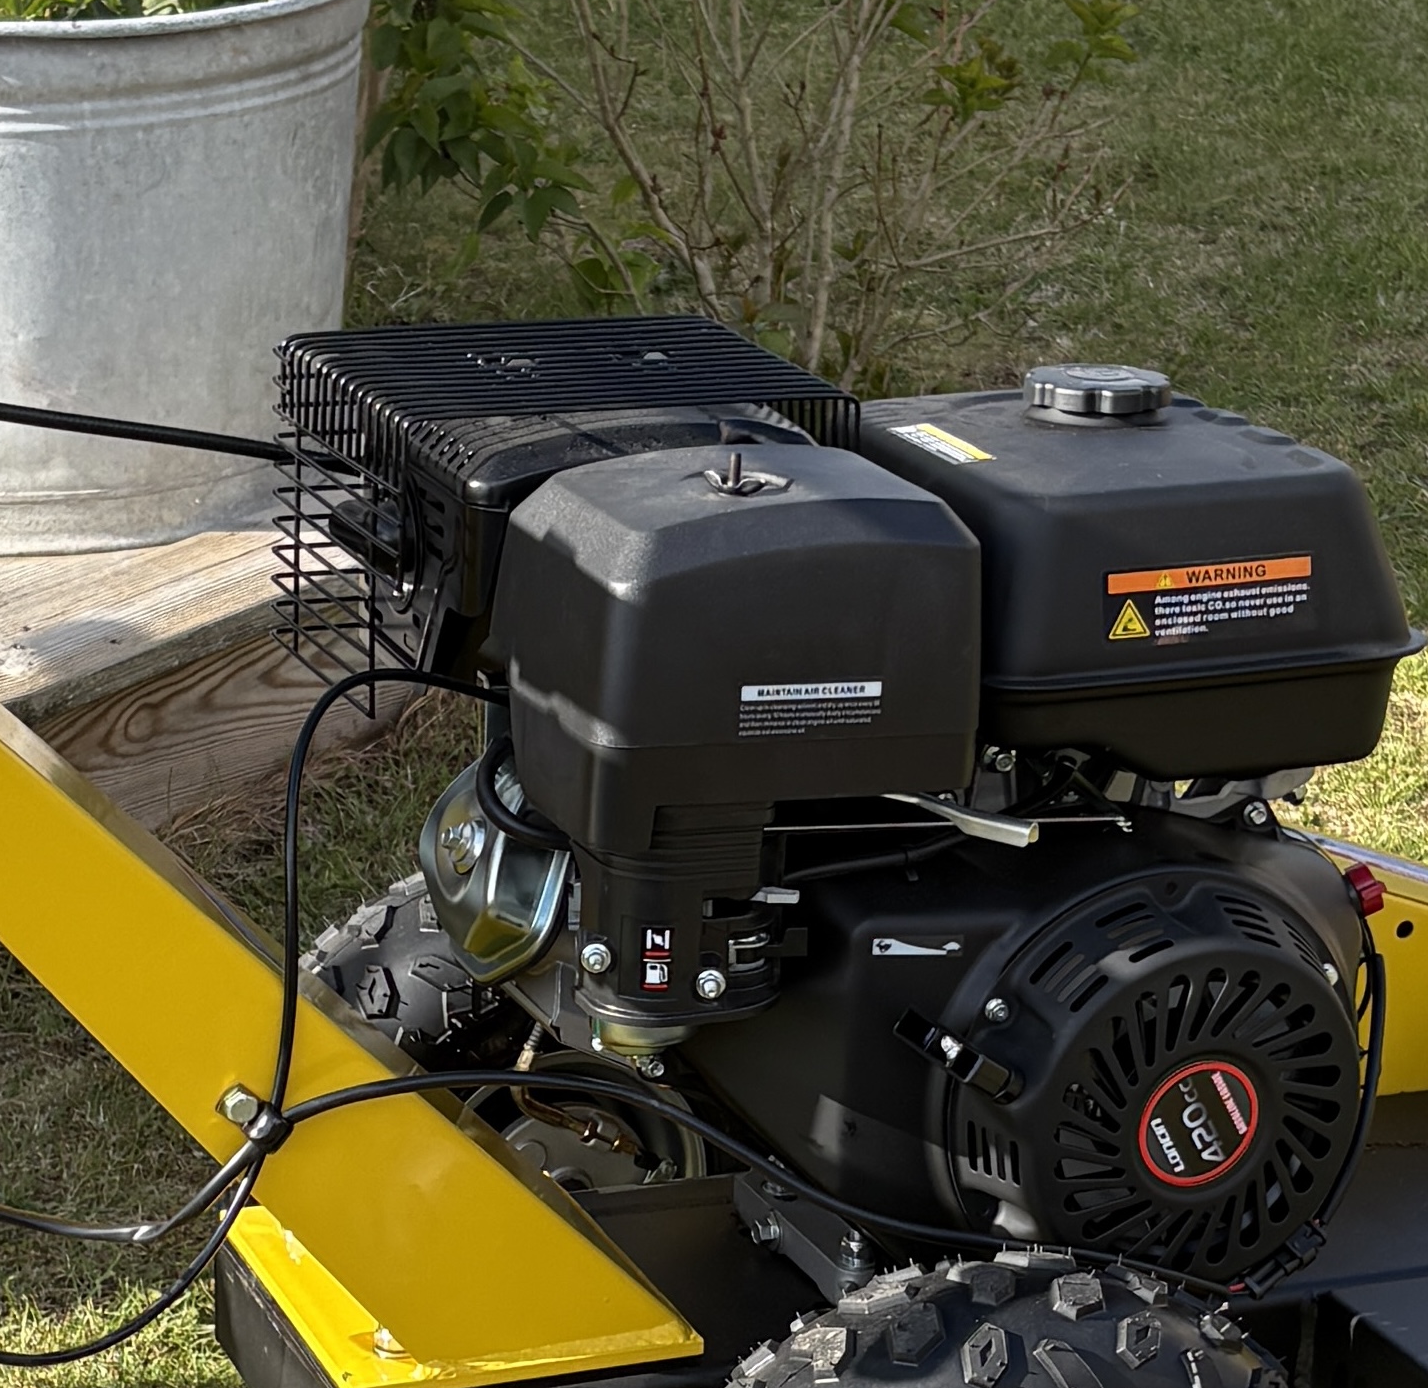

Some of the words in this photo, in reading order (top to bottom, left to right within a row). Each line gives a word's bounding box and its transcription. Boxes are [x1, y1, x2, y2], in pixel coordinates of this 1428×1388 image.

[1186, 564, 1267, 584] WARNING
[1155, 605, 1180, 615] there
[1238, 598, 1265, 608] never
[1266, 597, 1283, 605] use
[1285, 594, 1293, 603] in
[1295, 593, 1307, 602] an
[1190, 590, 1222, 602] engine
[1202, 610, 1229, 621] room
[1230, 607, 1268, 619] without
[1269, 604, 1294, 617] good
[757, 687, 802, 697] MAINTAIN
[804, 686, 820, 696] AIR
[821, 685, 866, 695] CLEANER
[1178, 1077, 1227, 1162] 420cc
